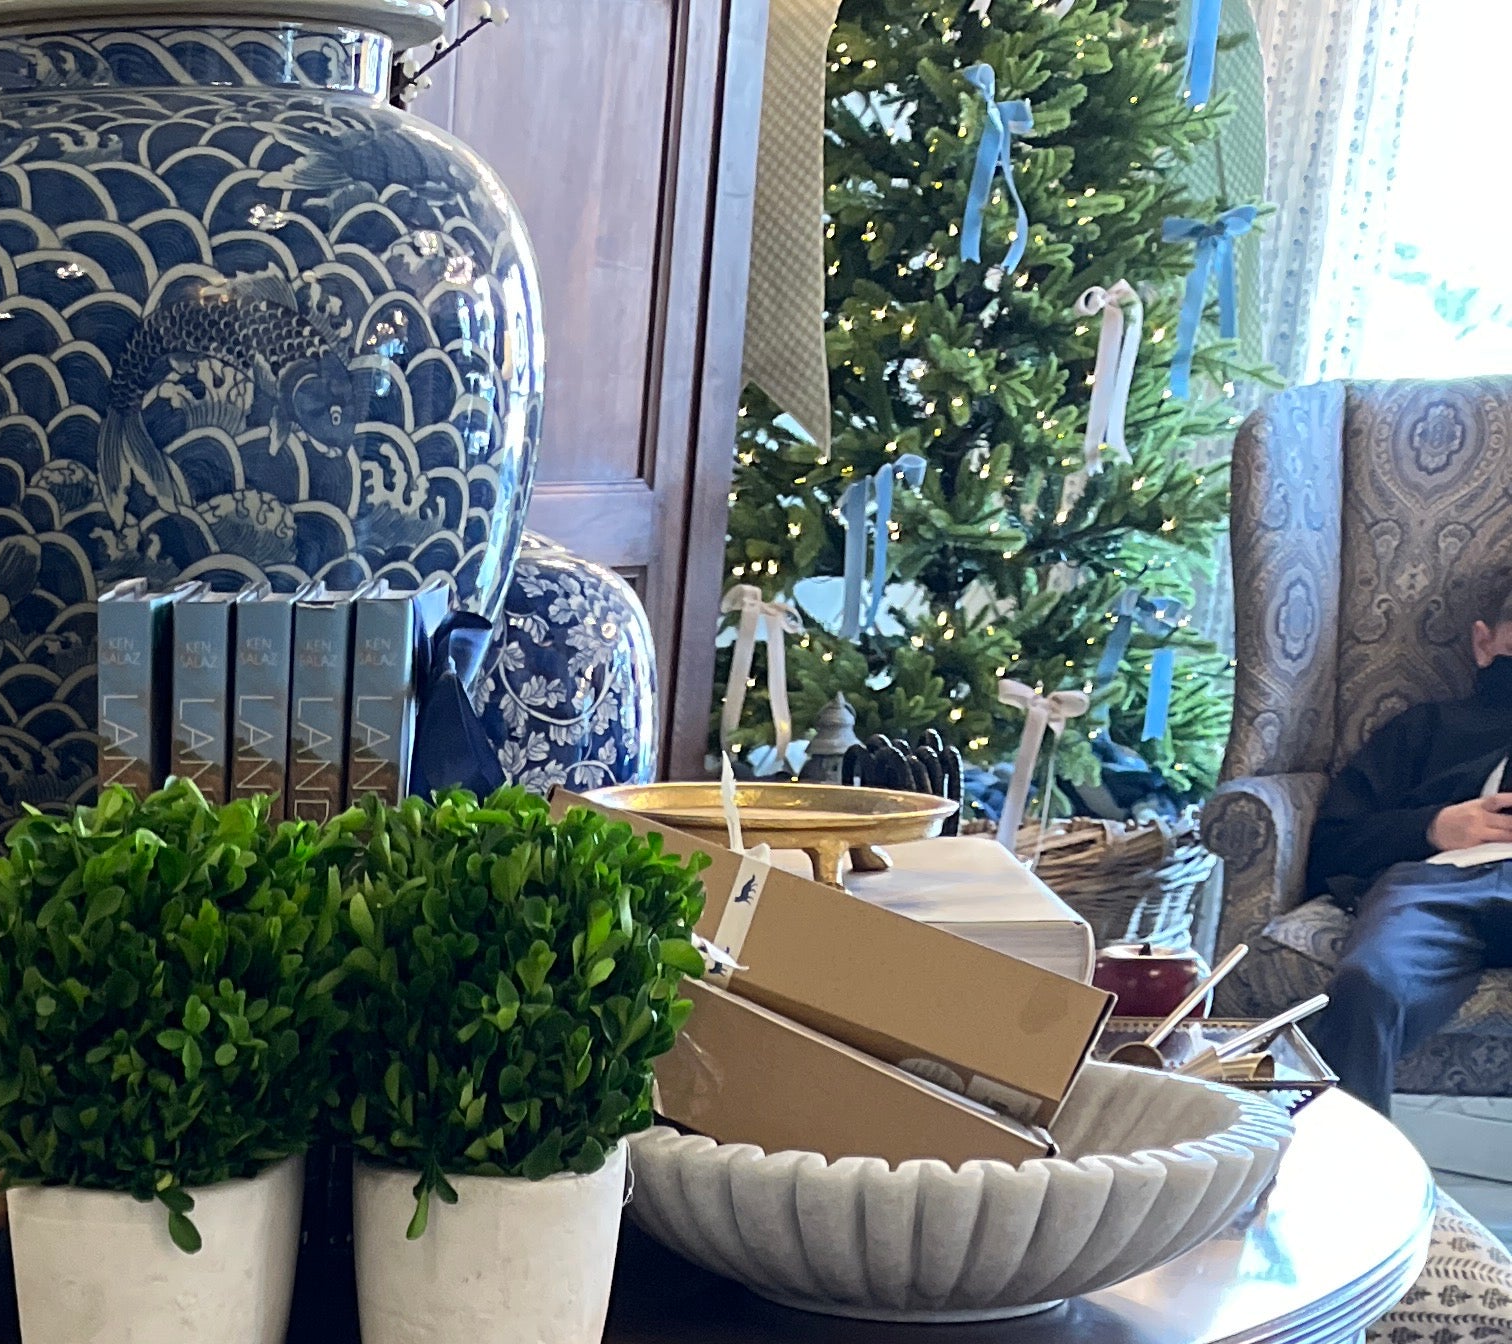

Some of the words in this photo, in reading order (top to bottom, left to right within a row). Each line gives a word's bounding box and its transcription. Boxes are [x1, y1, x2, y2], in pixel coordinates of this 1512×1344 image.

[108, 637, 134, 650] KEN
[185, 641, 211, 653] KEN
[246, 638, 272, 650] KEN
[306, 640, 331, 651] KEN
[366, 638, 391, 650] KEN
[179, 699, 216, 806] LAN
[352, 697, 393, 807] LAN
[237, 696, 274, 823] LAN
